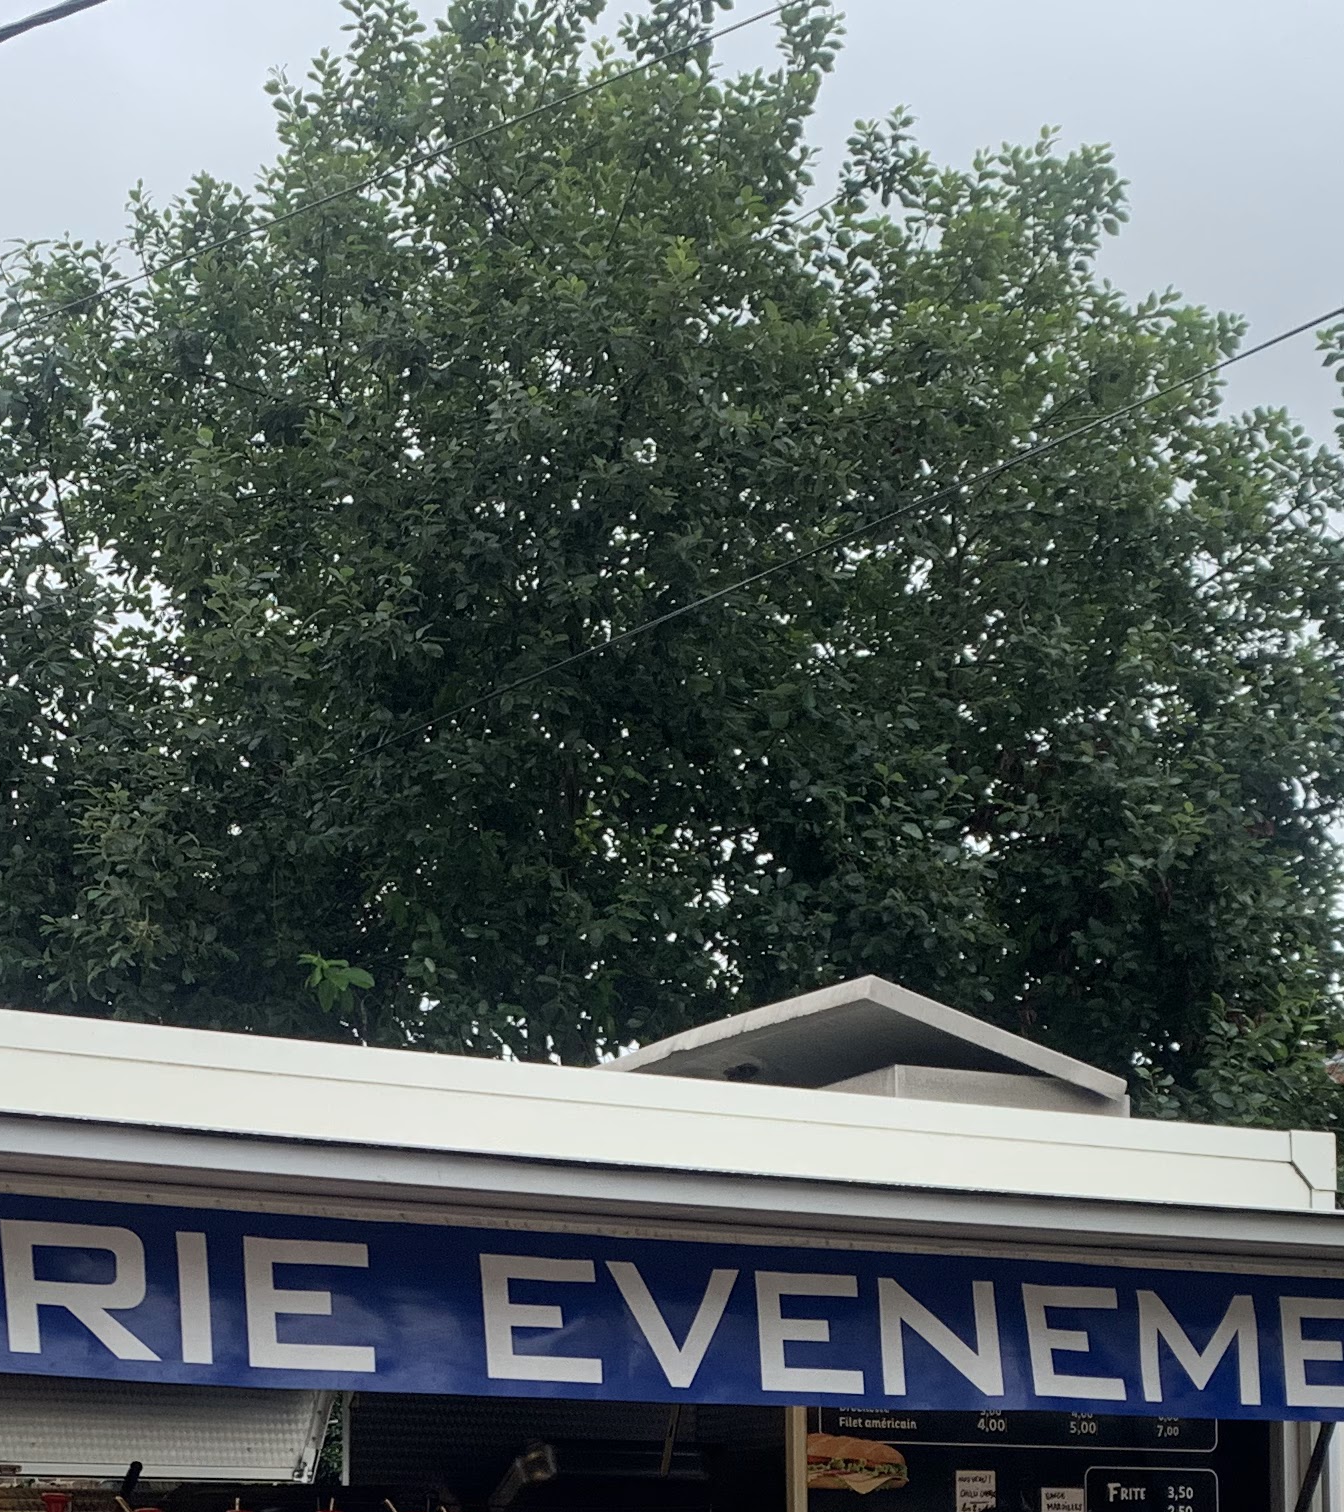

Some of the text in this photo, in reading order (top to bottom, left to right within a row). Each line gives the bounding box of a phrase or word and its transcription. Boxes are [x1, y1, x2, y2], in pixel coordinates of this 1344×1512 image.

[839, 1417, 1180, 1437] Filet américain 4,00 5,00 7,00
[1168, 1486, 1194, 1501] 3,50
